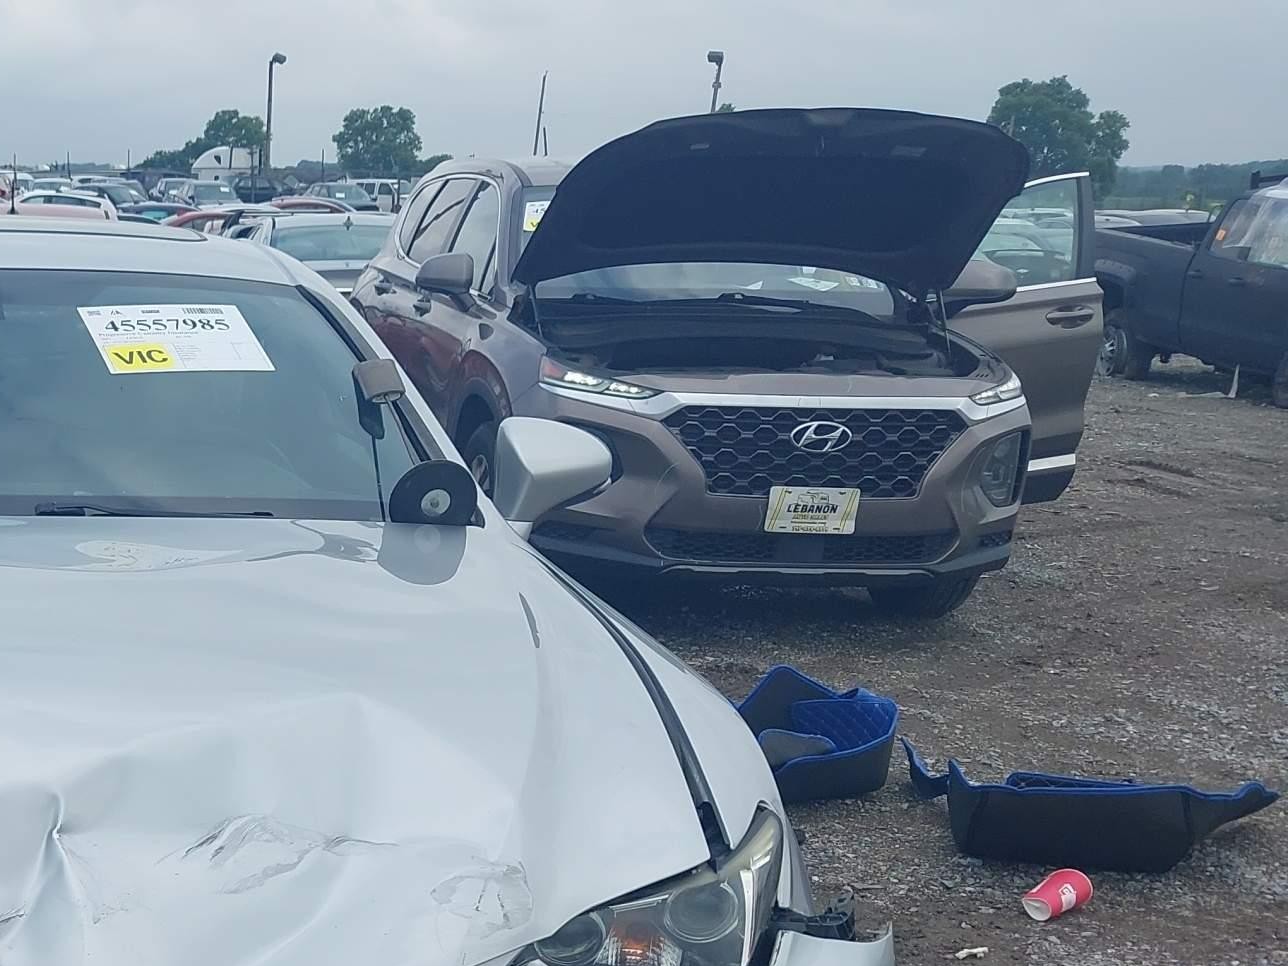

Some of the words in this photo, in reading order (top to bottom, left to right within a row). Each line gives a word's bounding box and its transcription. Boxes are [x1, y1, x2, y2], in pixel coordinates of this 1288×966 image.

[105, 318, 230, 332] 45557985
[113, 349, 169, 365] VIC
[786, 503, 839, 514] LEBANON
